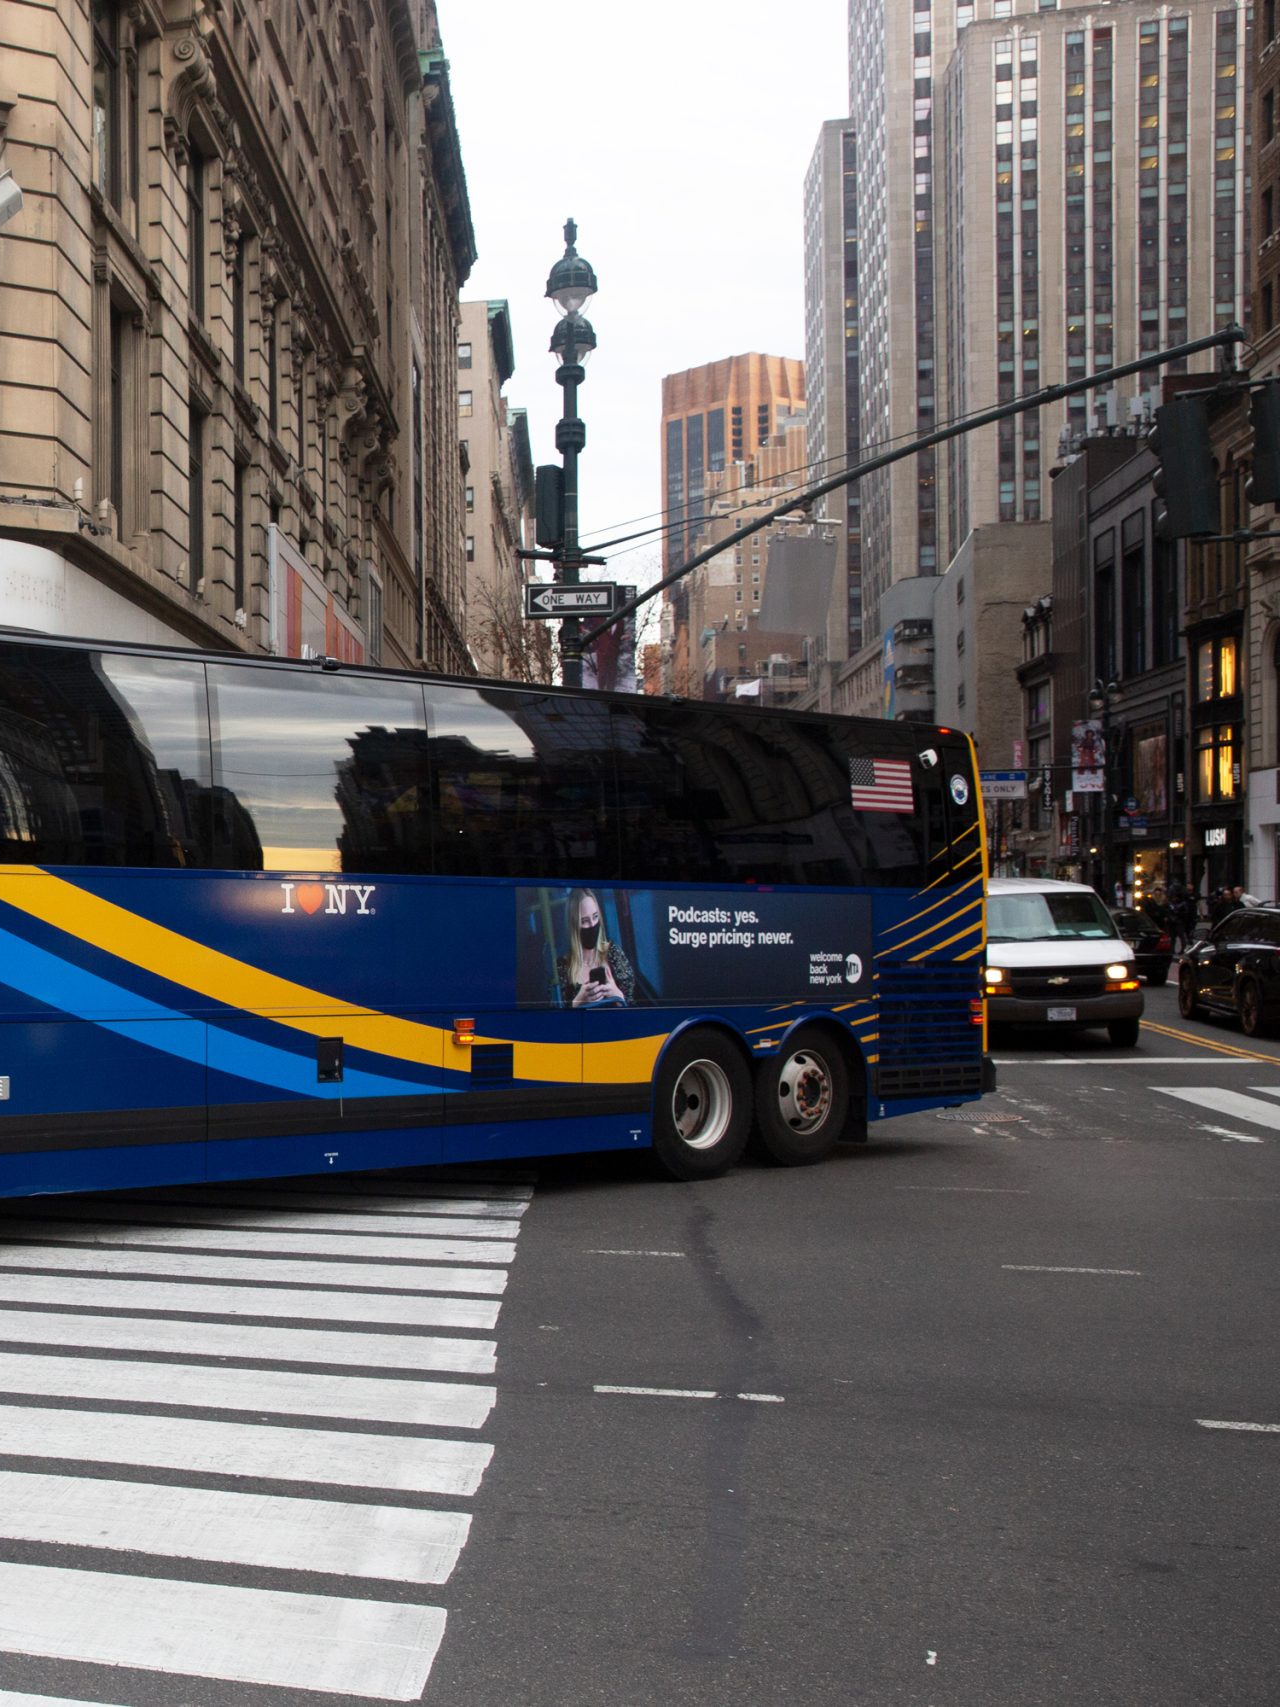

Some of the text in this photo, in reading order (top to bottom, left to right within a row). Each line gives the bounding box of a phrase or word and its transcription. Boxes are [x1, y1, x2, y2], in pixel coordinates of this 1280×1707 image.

[542, 593, 601, 605] ONE WAY
[1233, 763, 1241, 784] LUSH
[993, 784, 1017, 793] ONLY
[1176, 772, 1184, 793] LUSH
[1205, 828, 1227, 847] LUSH
[280, 883, 295, 914] I
[668, 905, 759, 926] Podcasts: yes.
[669, 927, 794, 948] Surge pricing: never.
[809, 951, 843, 962] welcome
[809, 963, 828, 974] back
[846, 961, 859, 976] MTA
[809, 973, 842, 986] new york
